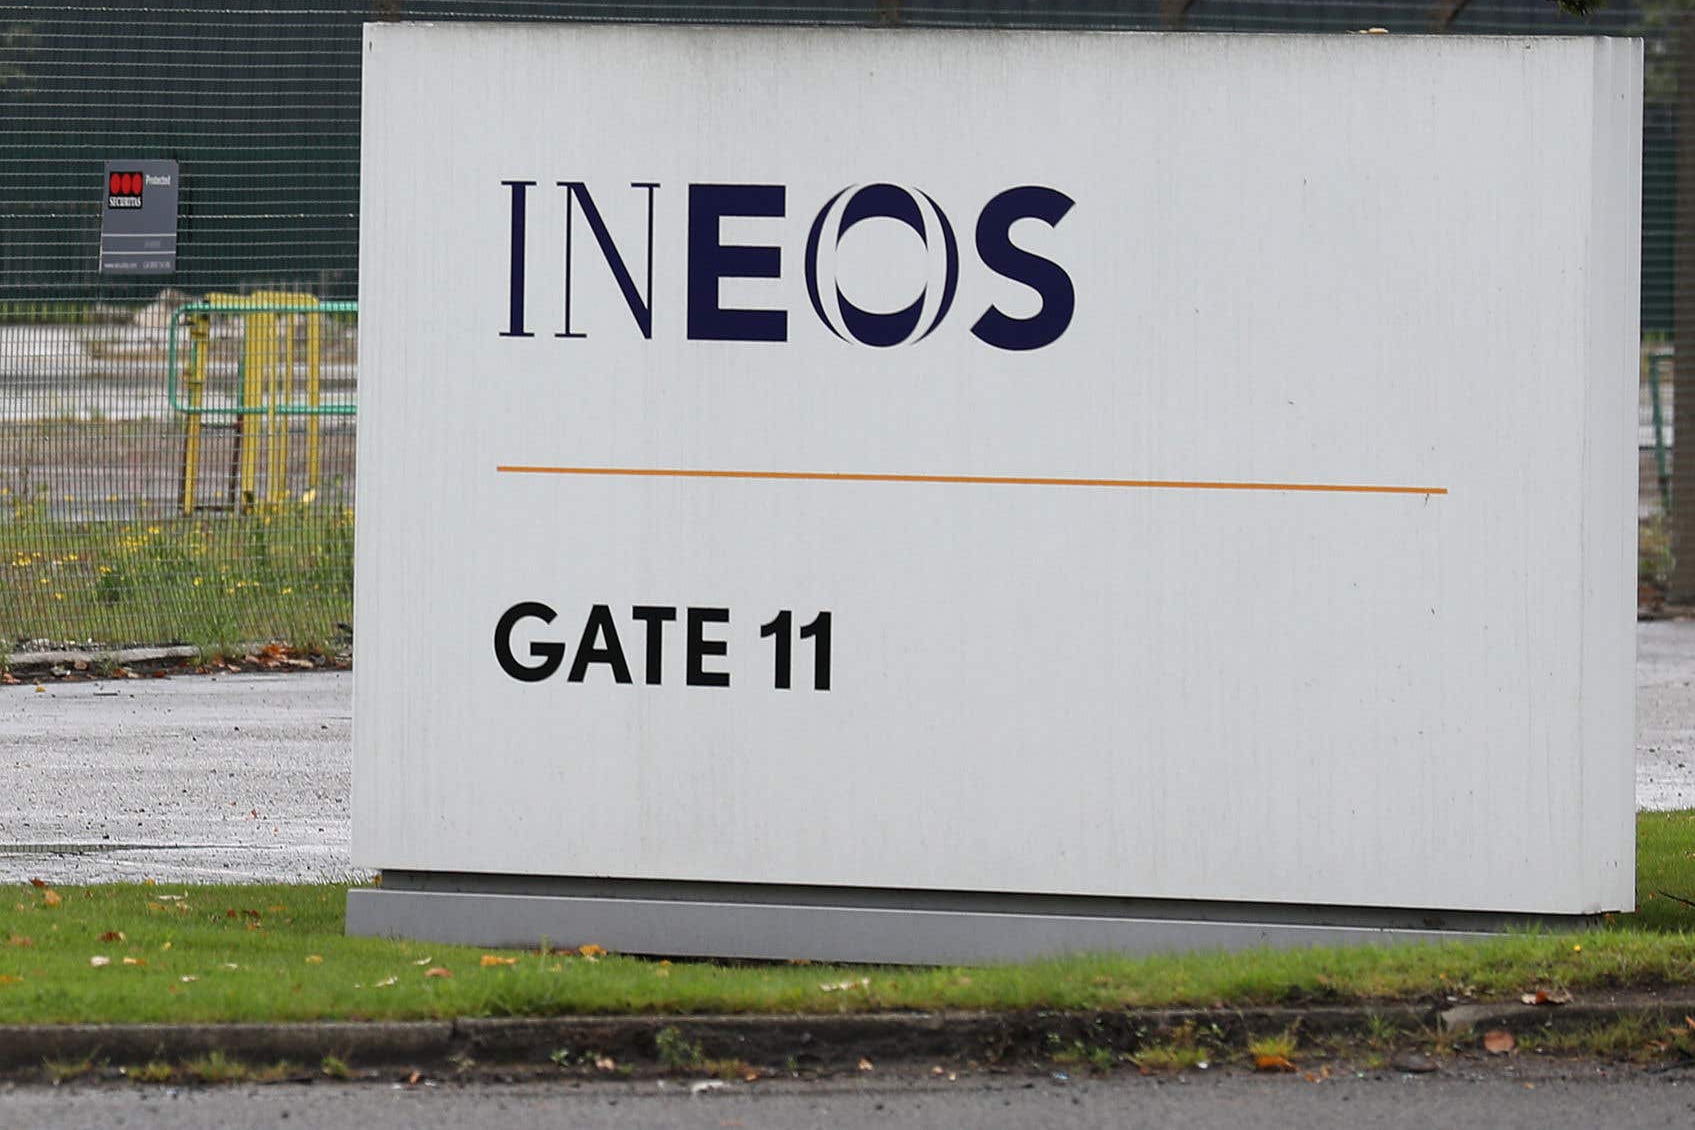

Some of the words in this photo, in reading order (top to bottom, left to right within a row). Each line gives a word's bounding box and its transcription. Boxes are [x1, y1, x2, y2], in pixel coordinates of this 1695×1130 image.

[109, 196, 142, 207] SECURITAS
[145, 174, 171, 186] Protected
[497, 180, 1076, 352] INEOS
[493, 601, 731, 688] GATE
[759, 609, 832, 692] 11
